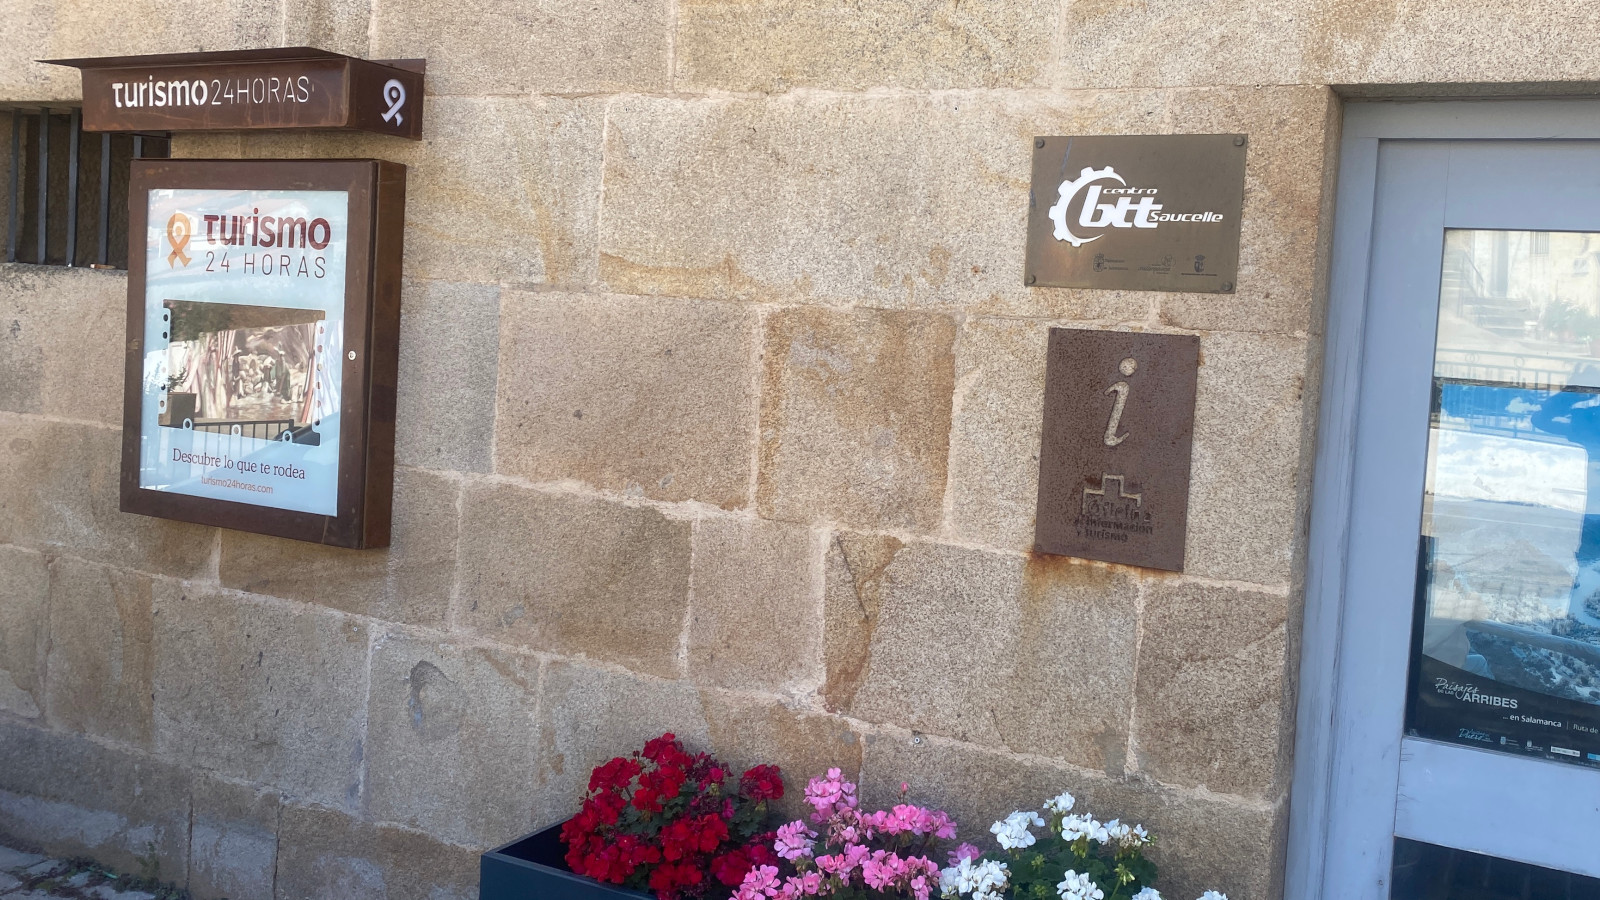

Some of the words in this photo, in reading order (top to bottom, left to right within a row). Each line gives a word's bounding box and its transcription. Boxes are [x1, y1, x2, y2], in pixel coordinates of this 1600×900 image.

[1102, 186, 1158, 195] centro
[1078, 185, 1163, 228] btt
[1149, 211, 1224, 223] Saucelle
[205, 251, 230, 273] 24
[244, 252, 326, 279] HORAS
[172, 448, 221, 468] Descubre
[224, 455, 234, 469] lo
[237, 460, 257, 474] que
[260, 462, 271, 474] te
[273, 464, 305, 480] rodea
[201, 476, 274, 494] turismo24horas.com
[1435, 677, 1480, 699] Paisajes
[1462, 693, 1518, 709] ARRIBES
[1521, 715, 1562, 728] Salamanca
[1590, 726, 1599, 734] de
